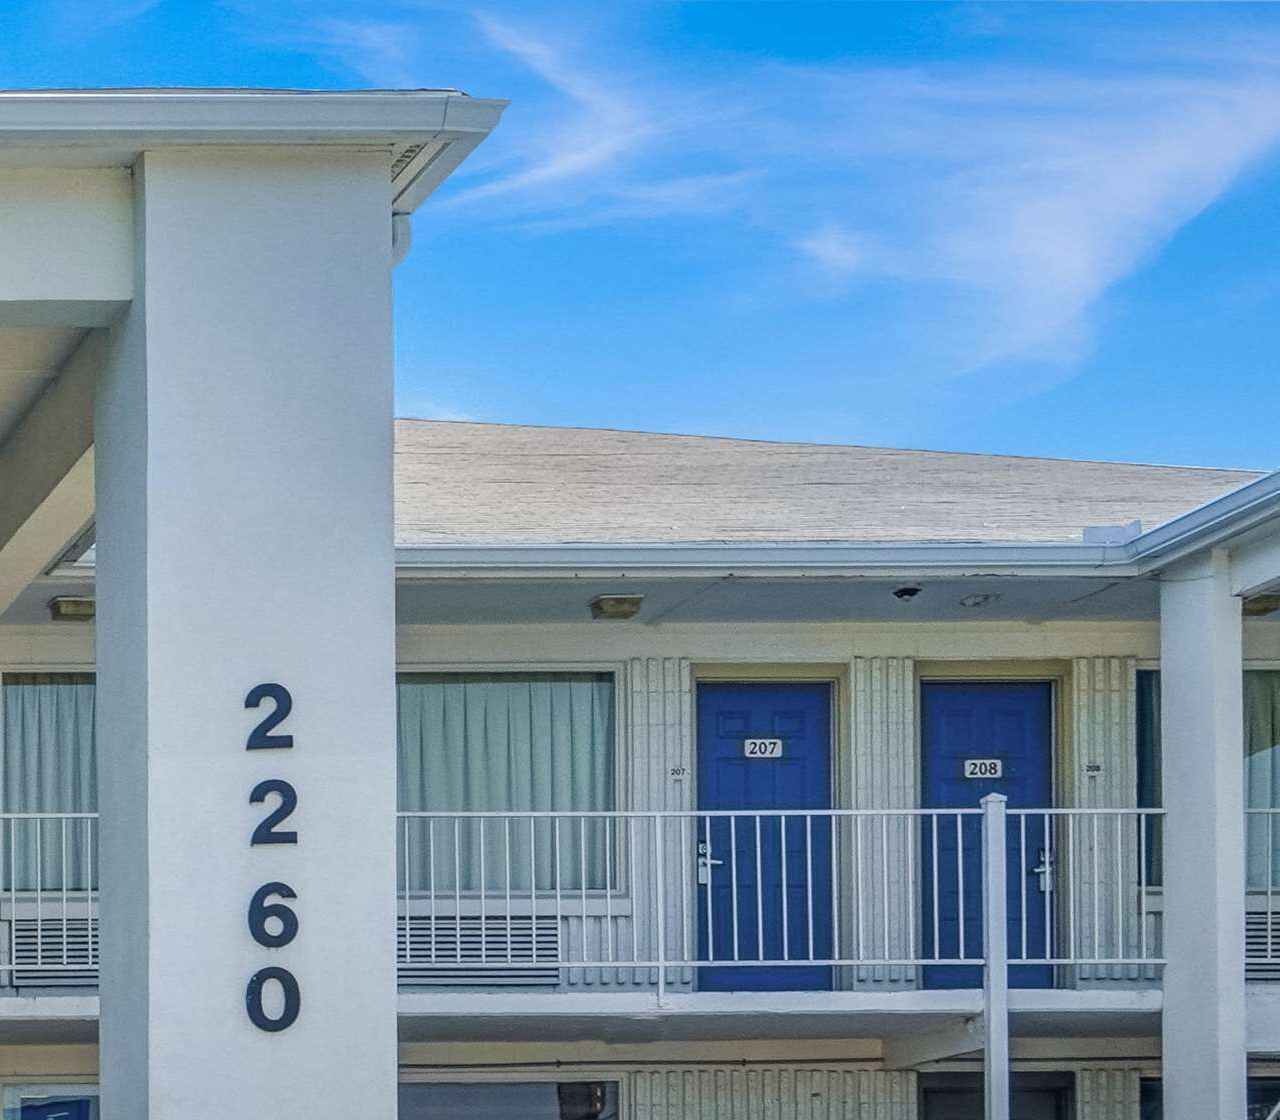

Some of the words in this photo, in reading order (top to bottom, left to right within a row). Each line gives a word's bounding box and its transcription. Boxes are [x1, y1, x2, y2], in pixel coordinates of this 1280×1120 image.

[749, 741, 778, 755] 207
[670, 768, 686, 776] 207
[968, 762, 997, 776] 208
[244, 683, 301, 1033] 2260
